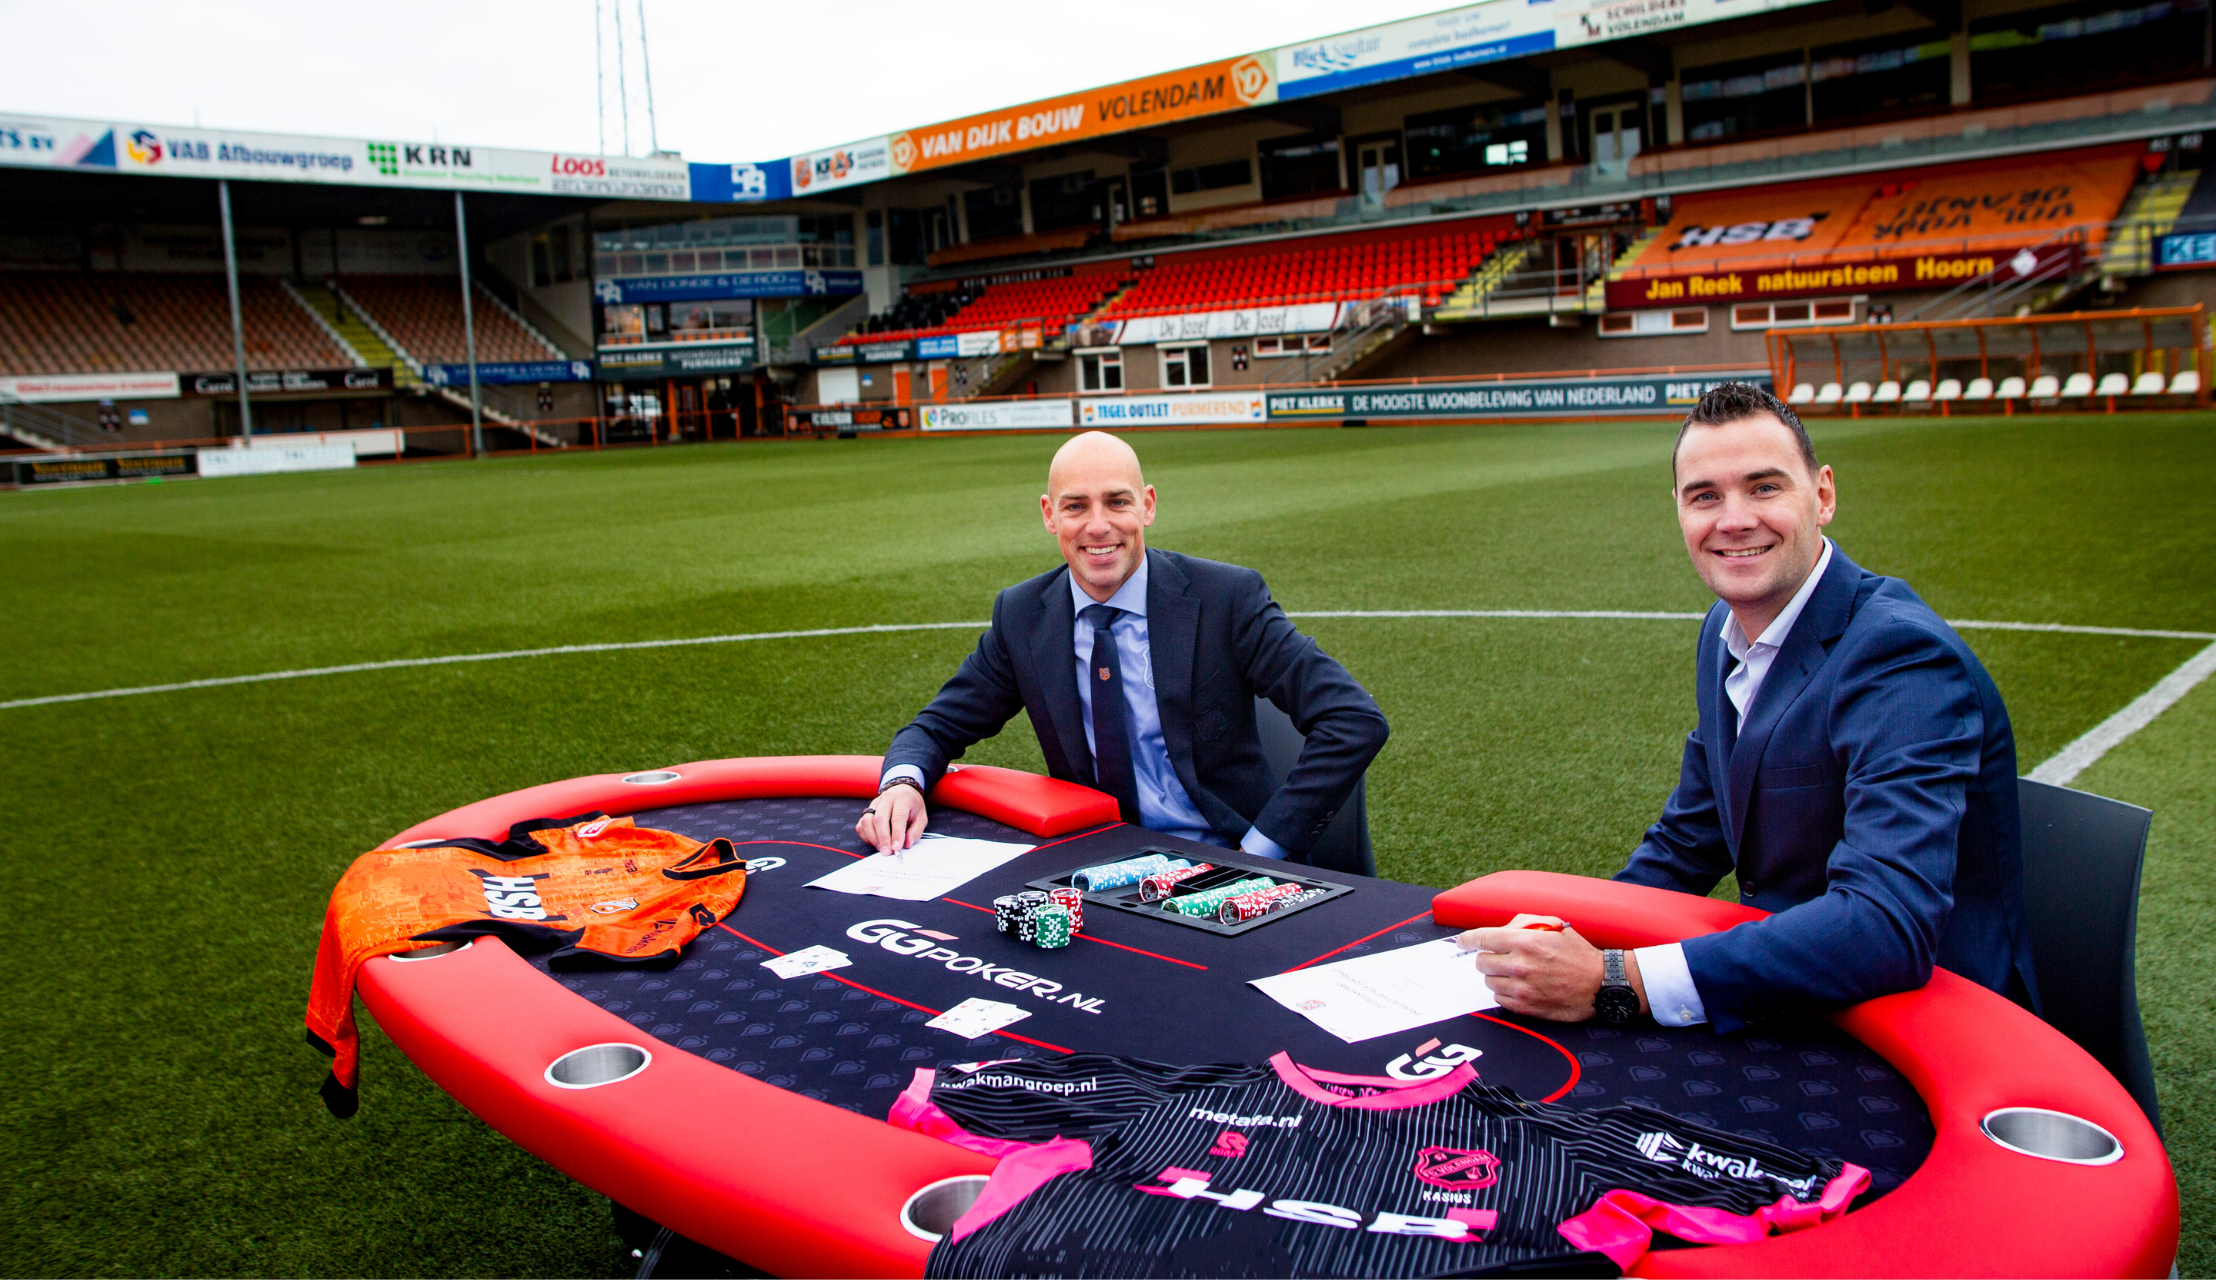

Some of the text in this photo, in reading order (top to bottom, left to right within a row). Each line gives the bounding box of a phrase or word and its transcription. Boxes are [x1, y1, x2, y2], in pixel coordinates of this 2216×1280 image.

[920, 74, 1226, 159] VAN DIJK BOUW VOLENDAM
[166, 138, 354, 172] VAB Afbouwgroep
[404, 143, 472, 167] KRN
[551, 153, 606, 178] LOOS
[1680, 215, 1819, 249] HSB
[1646, 256, 1995, 300] Jan Reek natuursteen Hoorn
[1233, 312, 1251, 332] De
[1097, 401, 1247, 419] TEGEL OUTLET PURMEREND
[1270, 397, 1299, 410] PIET
[1299, 394, 1345, 409] KLERKX
[1352, 395, 1370, 412] DE
[1371, 393, 1426, 411] MOOISTE
[1427, 388, 1532, 410] WOONBELEVING
[1534, 387, 1564, 408] VAN
[1567, 385, 1656, 406] NEDERLAND
[1665, 382, 1702, 399] PIET
[481, 876, 548, 921] HSB
[1189, 1106, 1303, 1128] metafa.nl
[1422, 1190, 1472, 1205] KASIUS
